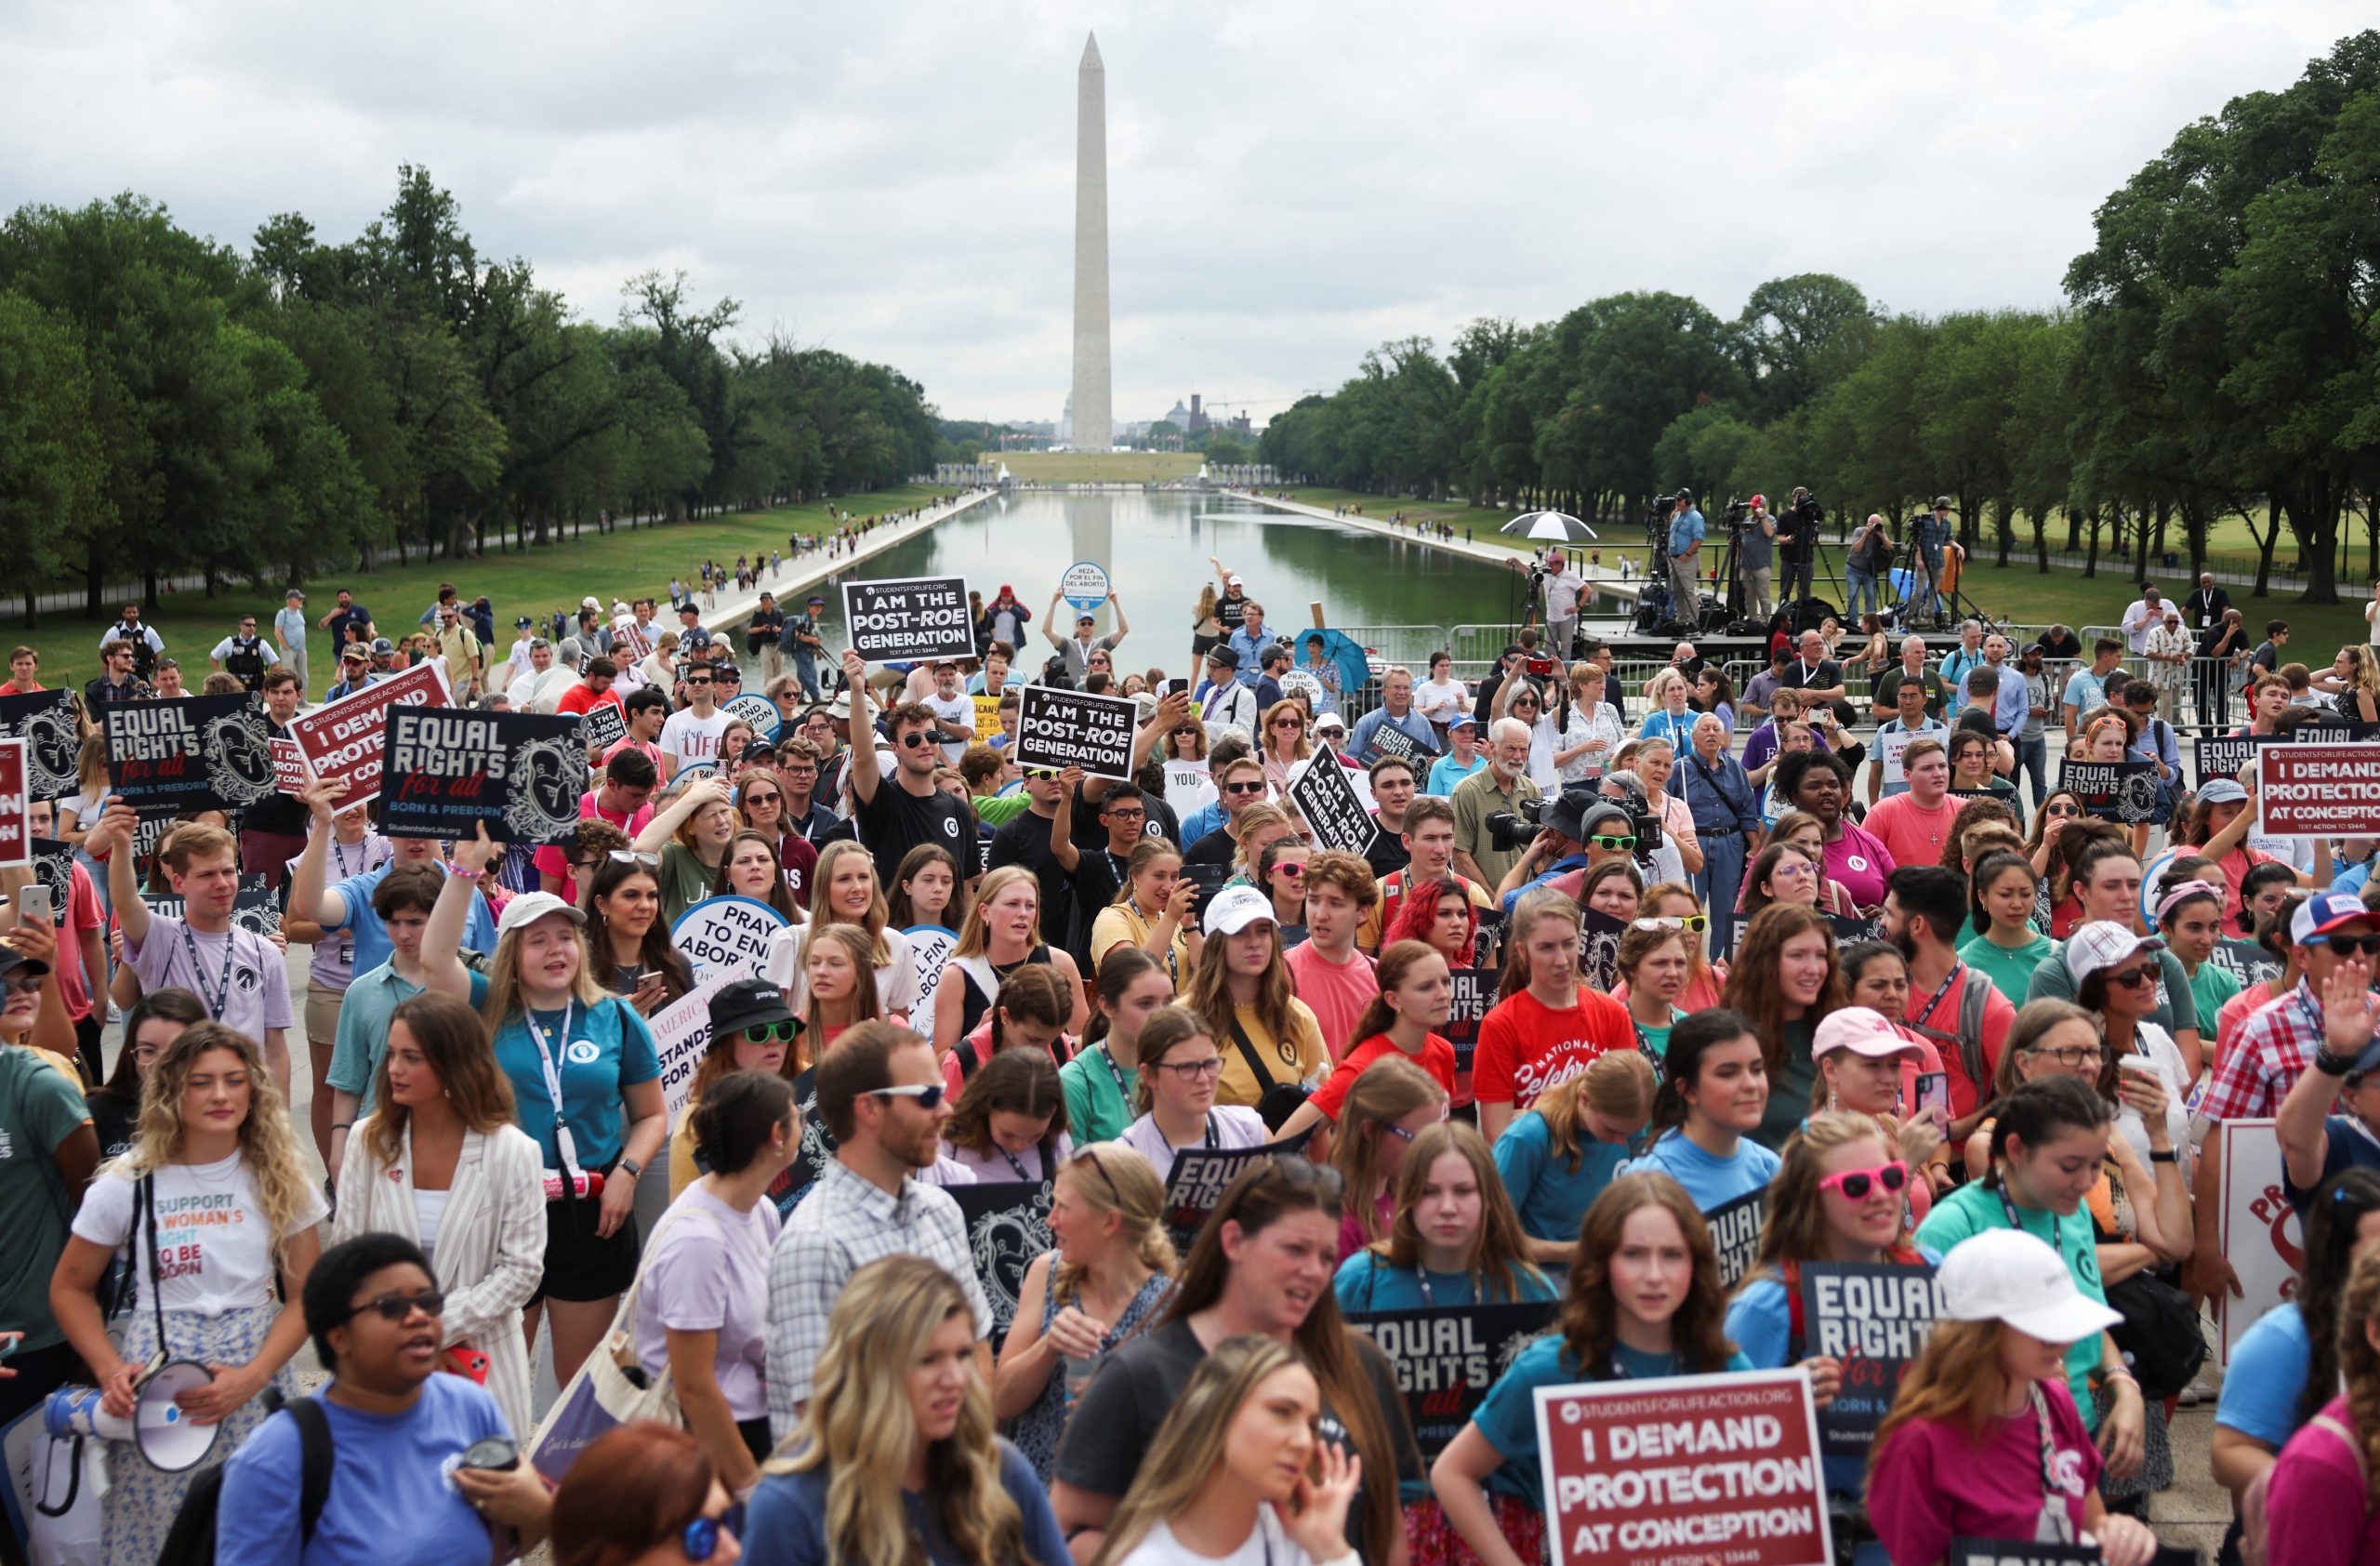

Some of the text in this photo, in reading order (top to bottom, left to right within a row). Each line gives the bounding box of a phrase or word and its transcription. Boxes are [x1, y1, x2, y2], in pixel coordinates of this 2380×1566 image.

[876, 584, 947, 593] STUDENTSFORLIFE.ORG
[856, 592, 957, 611] I AM THE
[853, 608, 965, 631] POST-ROE
[858, 629, 966, 649] GENERATION
[581, 657, 589, 675] THE
[313, 671, 430, 727] STUDENTSFORLIFEACTION.ORG
[1051, 696, 1118, 711] STUDENTSFORLIFE.ORG
[108, 706, 195, 738] EQUAL
[596, 712, 615, 724] THE
[739, 704, 760, 720] END
[748, 709, 773, 726] TION
[1030, 701, 1125, 727] I AM THE
[318, 730, 329, 747] I
[396, 715, 508, 751] EQUAL
[590, 719, 622, 737] T-ROE
[590, 730, 624, 747] ERATION
[681, 728, 703, 741] Pro
[1023, 717, 1130, 748] POST-ROE
[1377, 724, 1413, 752] EQUAL
[111, 733, 201, 762] RIGHTS
[278, 750, 283, 759] I
[313, 730, 385, 776] PROTE
[684, 737, 721, 757] LIFE
[1024, 737, 1125, 765] GENERATION
[1372, 734, 1410, 761] RIGHTS
[2200, 742, 2257, 759] EQUAL
[2281, 750, 2380, 759] STUDENTSFORLIFEACTION.
[120, 750, 187, 787] for all
[393, 746, 507, 778] RIGHTS
[2201, 758, 2245, 774] RIGHT
[2279, 763, 2380, 778] I DEMAND
[398, 765, 441, 801] for
[448, 770, 488, 798] all
[1174, 773, 1196, 786] YOU
[2065, 764, 2119, 782] EQUAL
[147, 786, 155, 795] &
[157, 781, 209, 793] PREBORN
[2064, 779, 2119, 794] RIGHTS
[2265, 783, 2380, 800] PROTECTIO
[390, 801, 502, 817] BORN & PREBORN
[1318, 758, 1368, 840] I AM THE
[1301, 781, 1348, 855] GENERATIO
[1307, 765, 1363, 856] POST-ROE
[2269, 805, 2380, 819] AT CONCEPTIO
[388, 824, 461, 835] StudentsforLife.org
[705, 920, 732, 942] TO
[723, 906, 778, 937] PRAY
[924, 937, 947, 964] FIN
[654, 996, 710, 1042] AMERICA
[1448, 1001, 1484, 1021] HTS
[1536, 1039, 1597, 1068] NATIONAL
[661, 1061, 690, 1092] FOR
[156, 1194, 234, 1214] SUPPORT
[1167, 1184, 1222, 1209] RIG
[163, 1209, 244, 1229] WOMAN'S
[1706, 1201, 1763, 1255] QUAL
[156, 1228, 197, 1247] IGHT
[178, 1244, 202, 1262] BE
[156, 1261, 202, 1281] BORN
[1814, 1275, 1949, 1320] EQUAL
[1818, 1319, 1935, 1359] RIGHT
[1390, 1355, 1488, 1392] GHTS
[1838, 1345, 1886, 1395] for
[1421, 1376, 1467, 1415] all
[1582, 1389, 1792, 1419] STUDENTSFORLIFEACTION.ORG
[1876, 1399, 1887, 1413] &
[1581, 1414, 1781, 1463] I DEMAND
[1557, 1456, 1814, 1513] PROTECTION
[1573, 1506, 1813, 1555] AT CONCEPTION
[1660, 1555, 1703, 1566] ACTION
[1725, 1550, 1760, 1563] 53445
